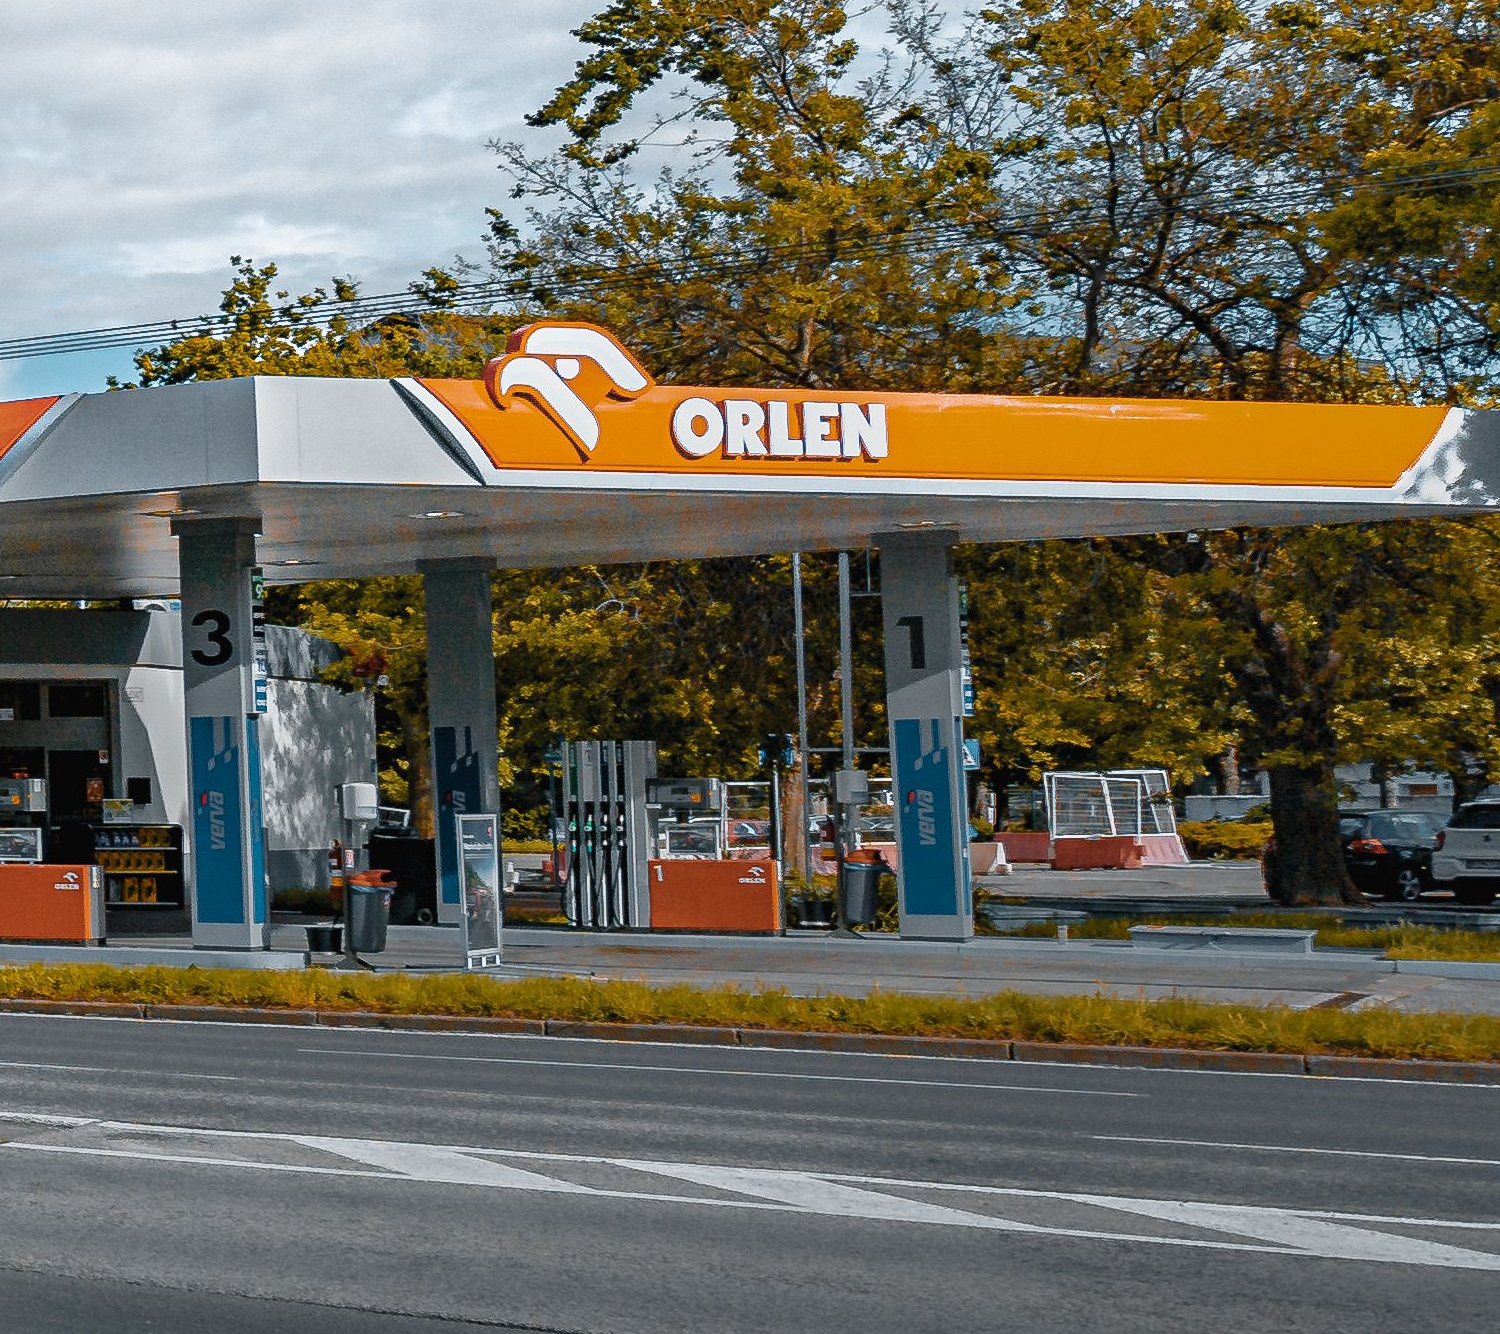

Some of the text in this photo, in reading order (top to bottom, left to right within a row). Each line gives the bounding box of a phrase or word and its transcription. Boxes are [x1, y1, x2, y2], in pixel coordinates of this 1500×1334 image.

[671, 397, 889, 459] ORLEN
[190, 609, 233, 666] 3
[896, 616, 926, 669] 1
[209, 790, 226, 850] verva
[917, 789, 936, 846] verva
[653, 865, 664, 882] 1
